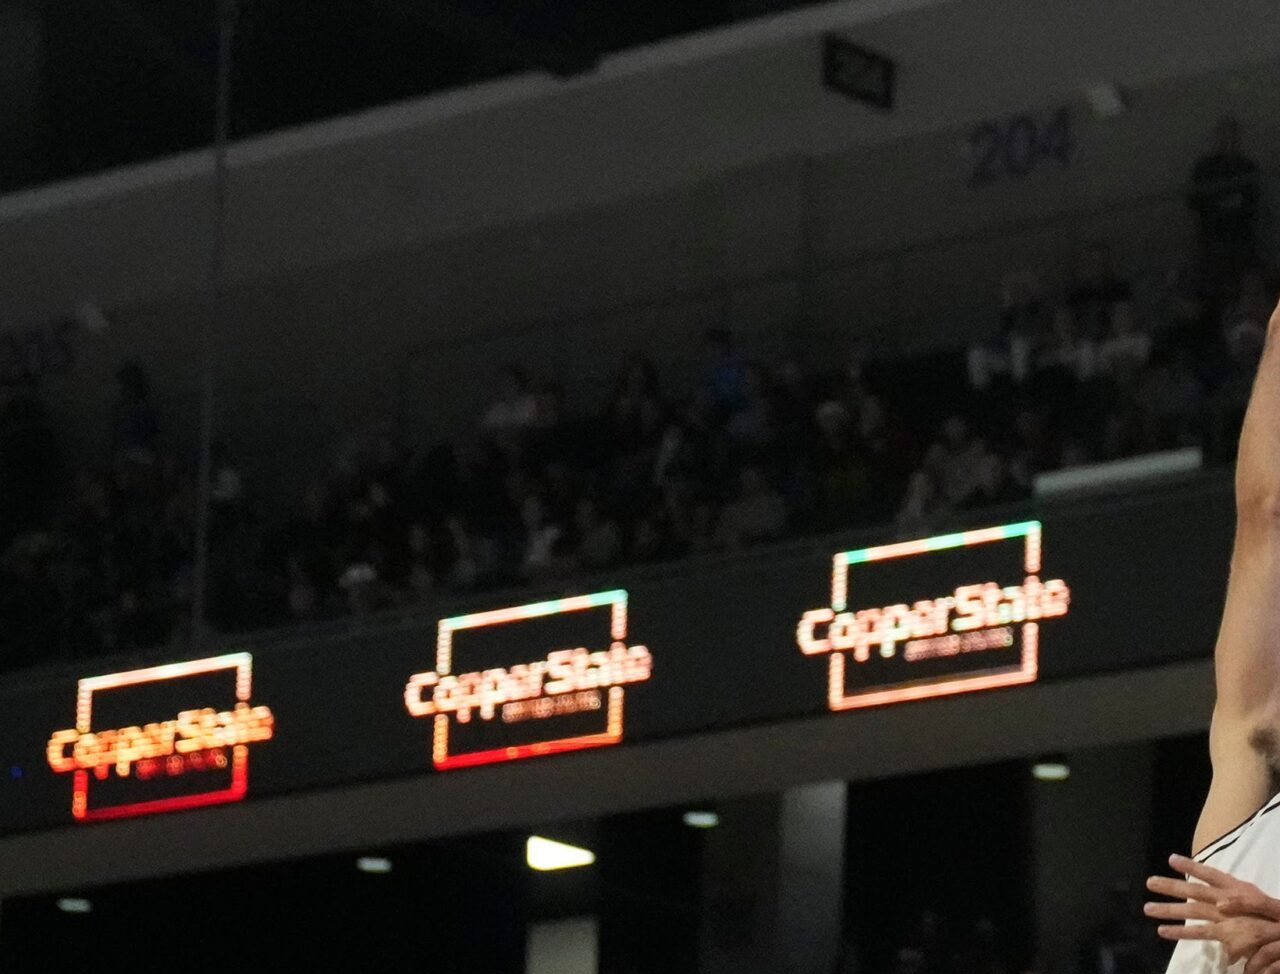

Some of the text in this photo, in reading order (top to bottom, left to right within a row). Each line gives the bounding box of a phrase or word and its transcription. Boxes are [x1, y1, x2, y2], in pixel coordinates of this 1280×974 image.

[797, 575, 1070, 662] CopperState
[404, 641, 653, 723] CopperState
[47, 702, 274, 780] CopperState
